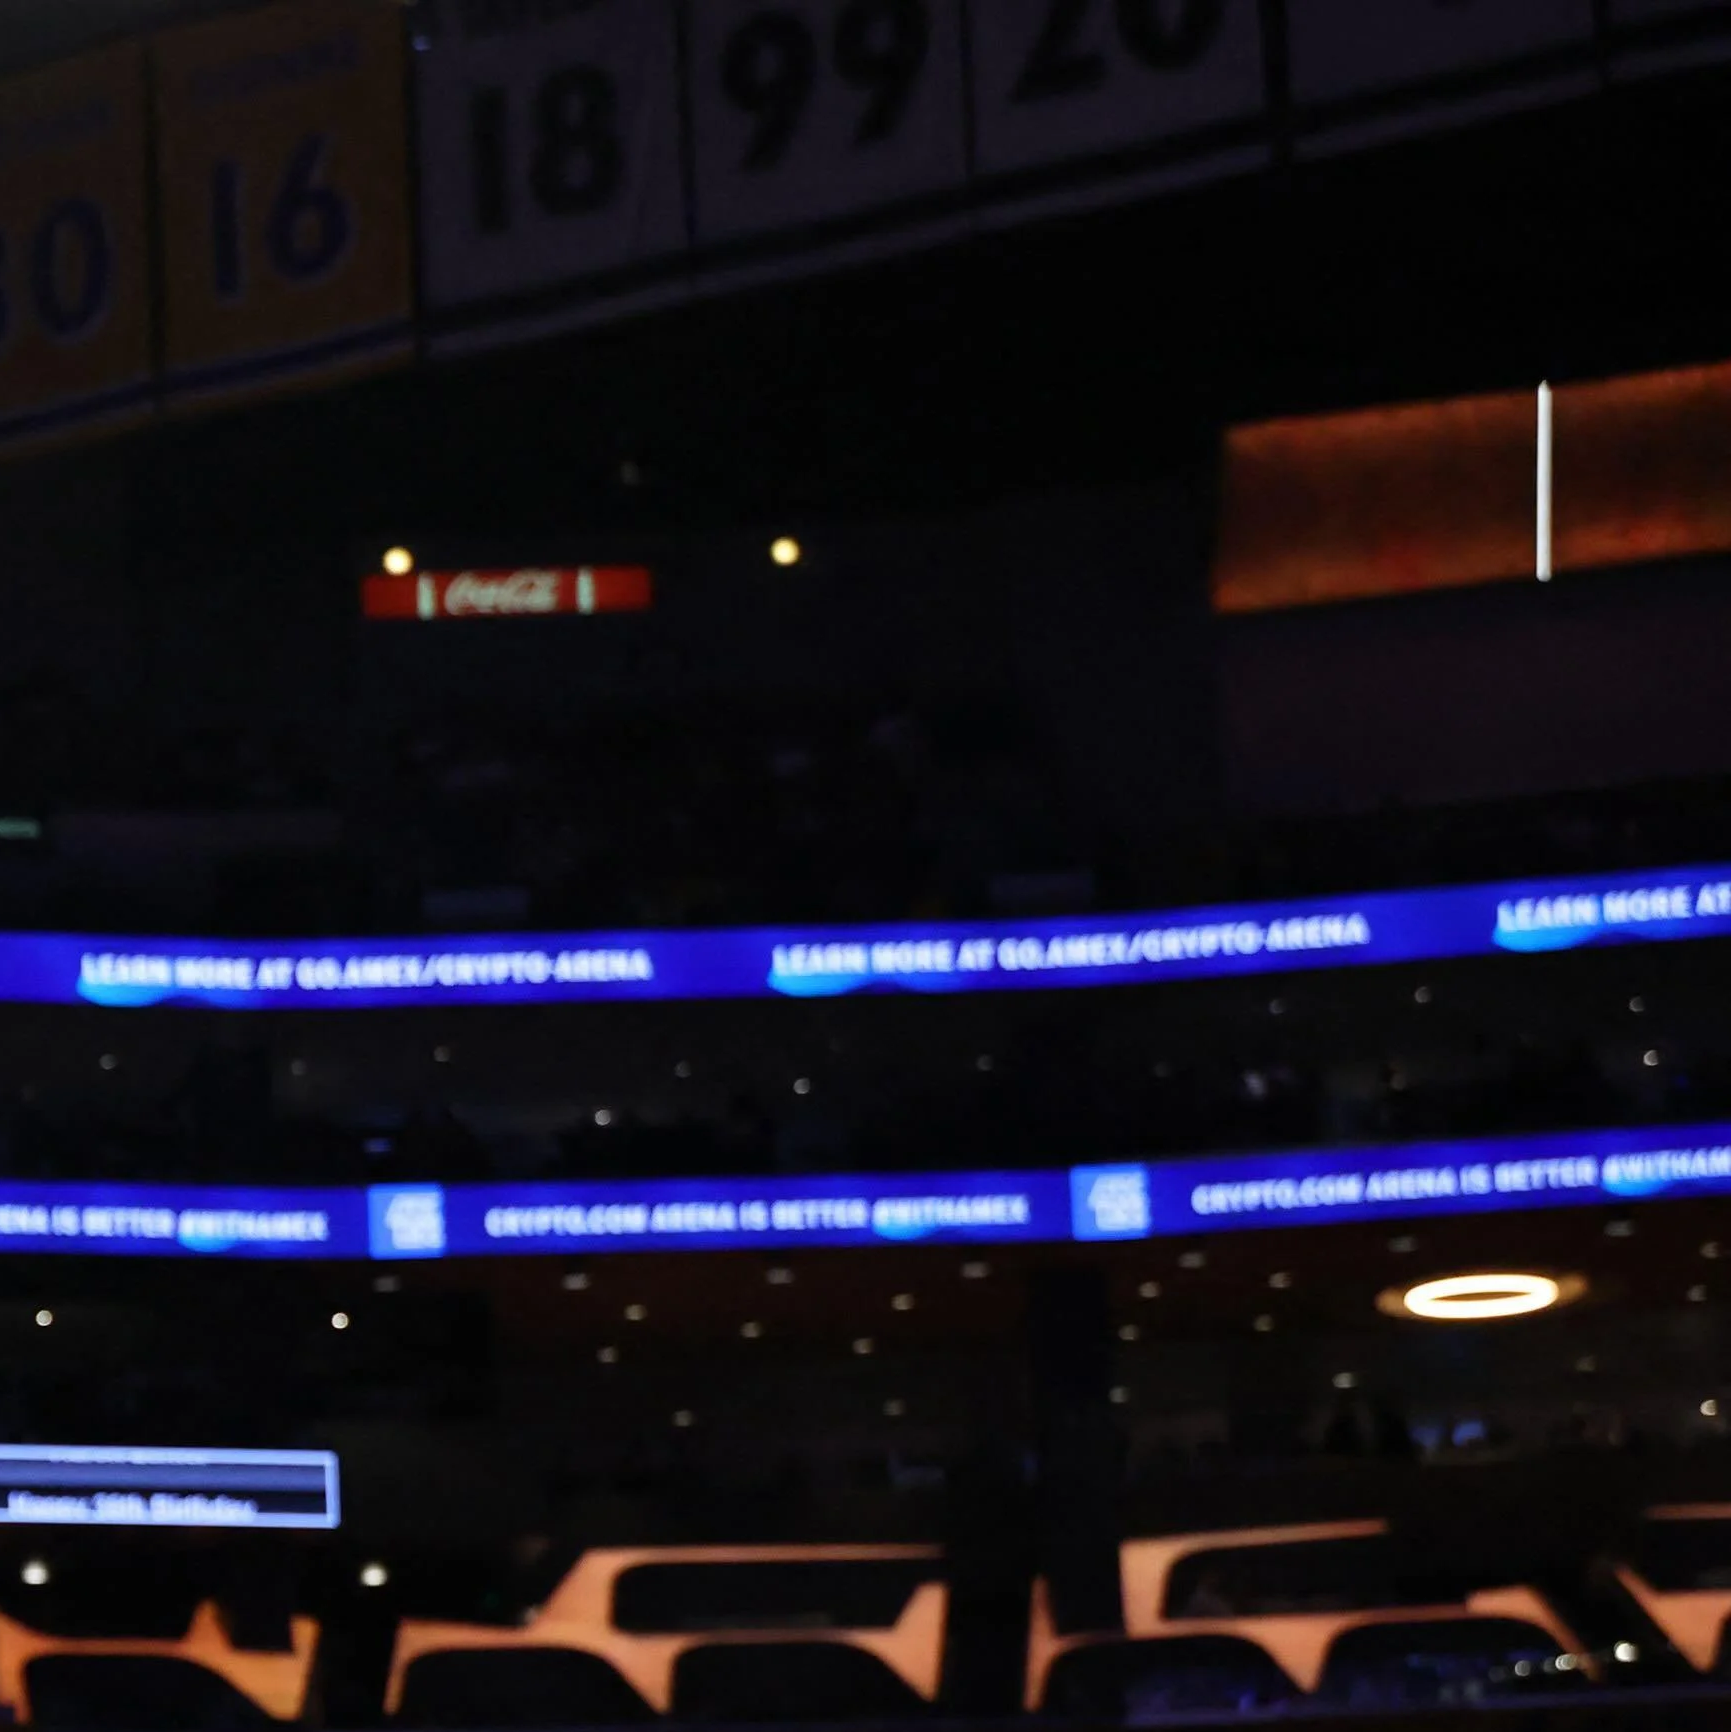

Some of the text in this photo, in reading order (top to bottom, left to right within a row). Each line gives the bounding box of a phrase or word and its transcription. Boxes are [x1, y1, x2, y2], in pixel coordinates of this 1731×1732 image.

[470, 62, 622, 236] 18
[720, 0, 930, 173] 99
[209, 134, 353, 305] 16
[1600, 1147, 1731, 1184] #WITHAM
